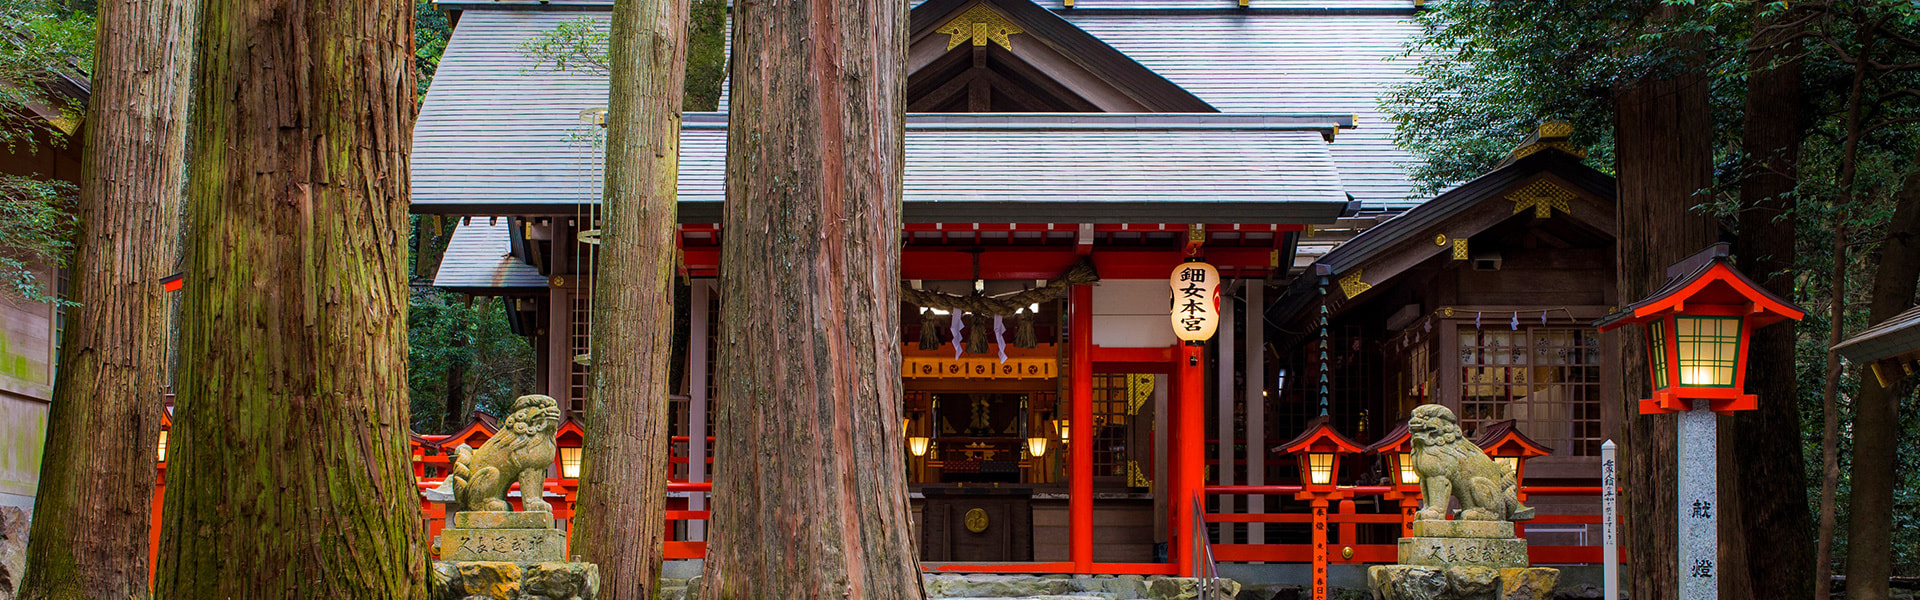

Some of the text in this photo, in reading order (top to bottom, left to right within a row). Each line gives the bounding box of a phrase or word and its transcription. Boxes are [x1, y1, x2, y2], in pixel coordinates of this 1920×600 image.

[1179, 266, 1206, 332] 鈿女本宮
[1691, 498, 1713, 578] 献燈
